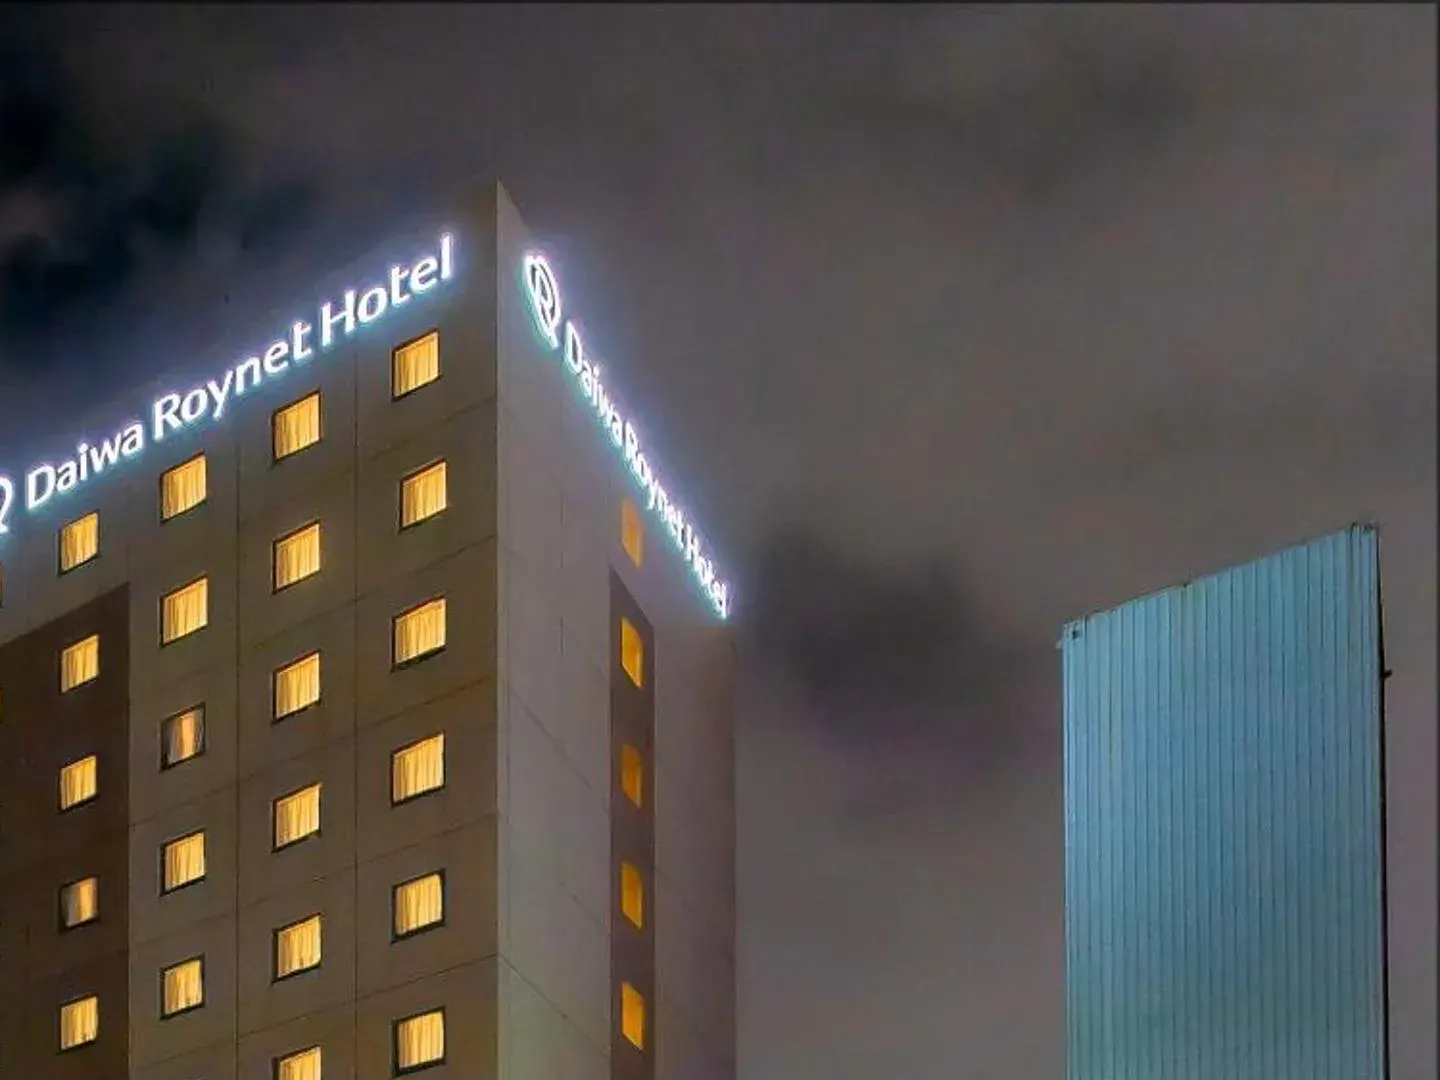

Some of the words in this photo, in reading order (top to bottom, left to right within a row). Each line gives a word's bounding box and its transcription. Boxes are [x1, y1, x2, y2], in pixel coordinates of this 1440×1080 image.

[25, 421, 145, 512] Daiwa
[152, 320, 313, 442] Roynet
[321, 232, 453, 346] Hotel
[563, 318, 623, 449] Daiwa
[623, 420, 684, 551] Roynet
[684, 522, 728, 620] Hotel
